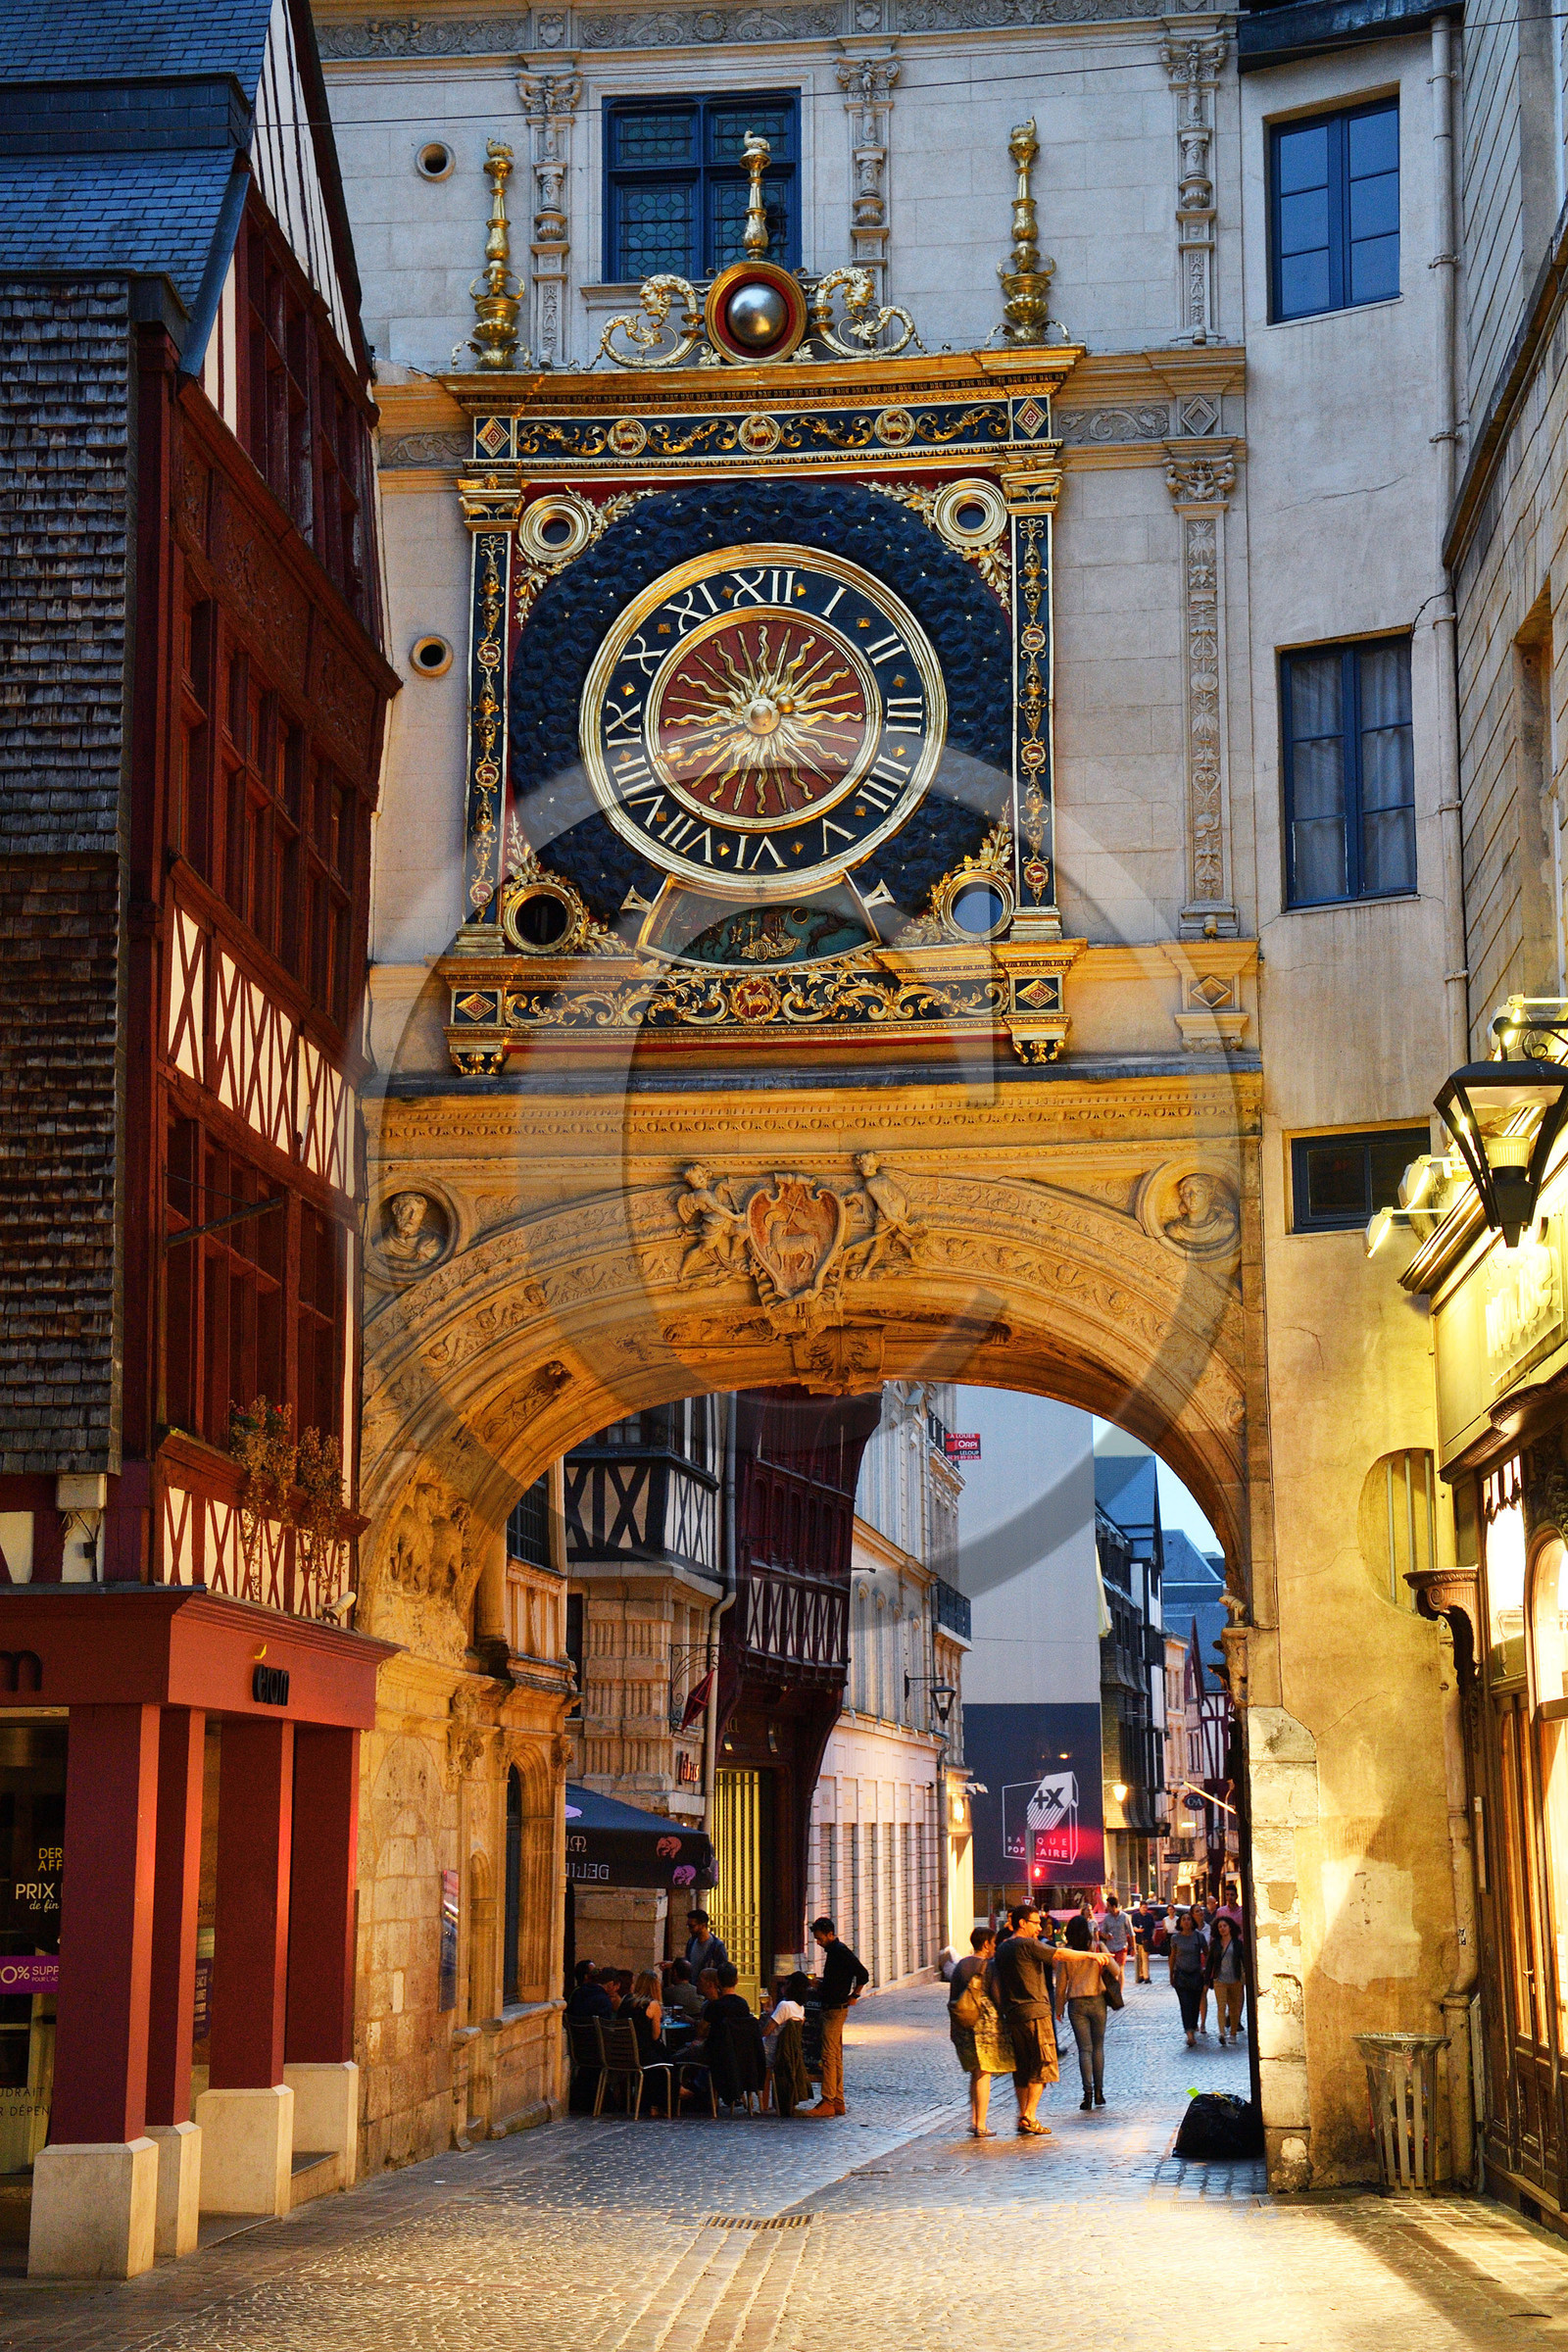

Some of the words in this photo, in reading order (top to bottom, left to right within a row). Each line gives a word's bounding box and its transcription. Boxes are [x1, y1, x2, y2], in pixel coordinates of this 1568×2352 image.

[729, 569, 796, 607] XII
[821, 586, 848, 618] I
[662, 582, 721, 635] XI
[619, 633, 668, 677] X
[864, 632, 906, 666] II
[605, 700, 643, 750] IX
[886, 696, 923, 734] III
[612, 755, 665, 829] VIII
[856, 754, 912, 813] IIII
[657, 809, 714, 865] VII
[732, 834, 788, 871] VI
[821, 817, 858, 857] V
[1007, 1836, 1067, 1846] BAQUE
[1007, 1845, 1068, 1858] POPAIRE
[15, 1883, 55, 1900] PRIX
[28, 1899, 41, 1910] de
[44, 1899, 60, 1913] fin
[0, 1965, 30, 1984] 0%
